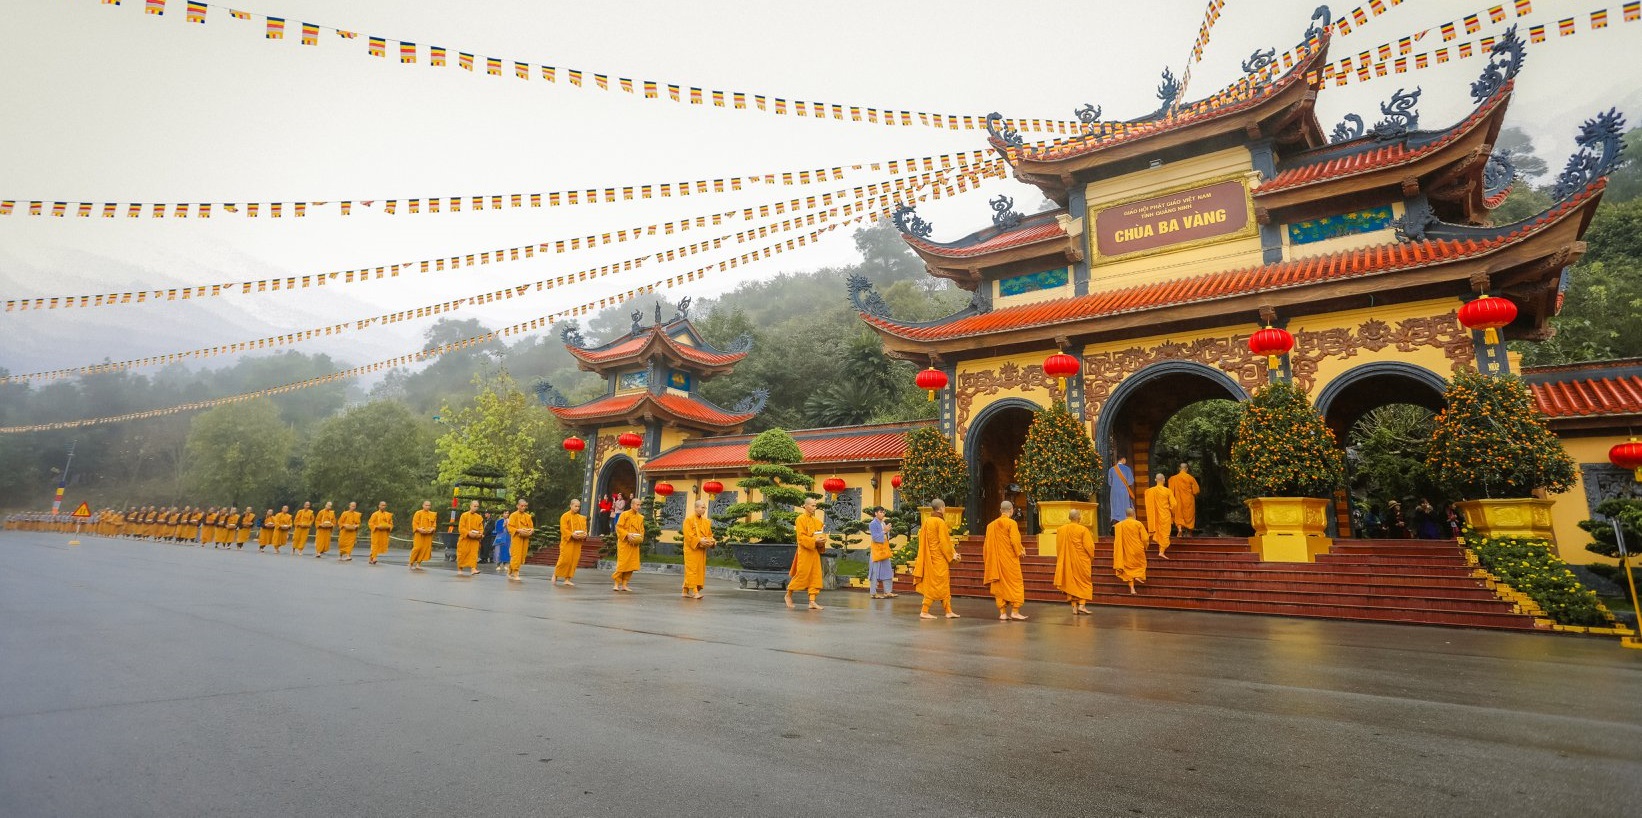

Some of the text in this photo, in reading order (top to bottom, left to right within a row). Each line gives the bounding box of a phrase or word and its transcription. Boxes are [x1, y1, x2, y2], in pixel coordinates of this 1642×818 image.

[1123, 208, 1138, 216] GIÁO
[1166, 199, 1181, 207] GIÁO
[1182, 196, 1196, 204] VIỆT
[1197, 192, 1212, 200] NAM
[1177, 204, 1193, 212] NINH
[1114, 208, 1227, 243] CHÙA BA VÀNG
